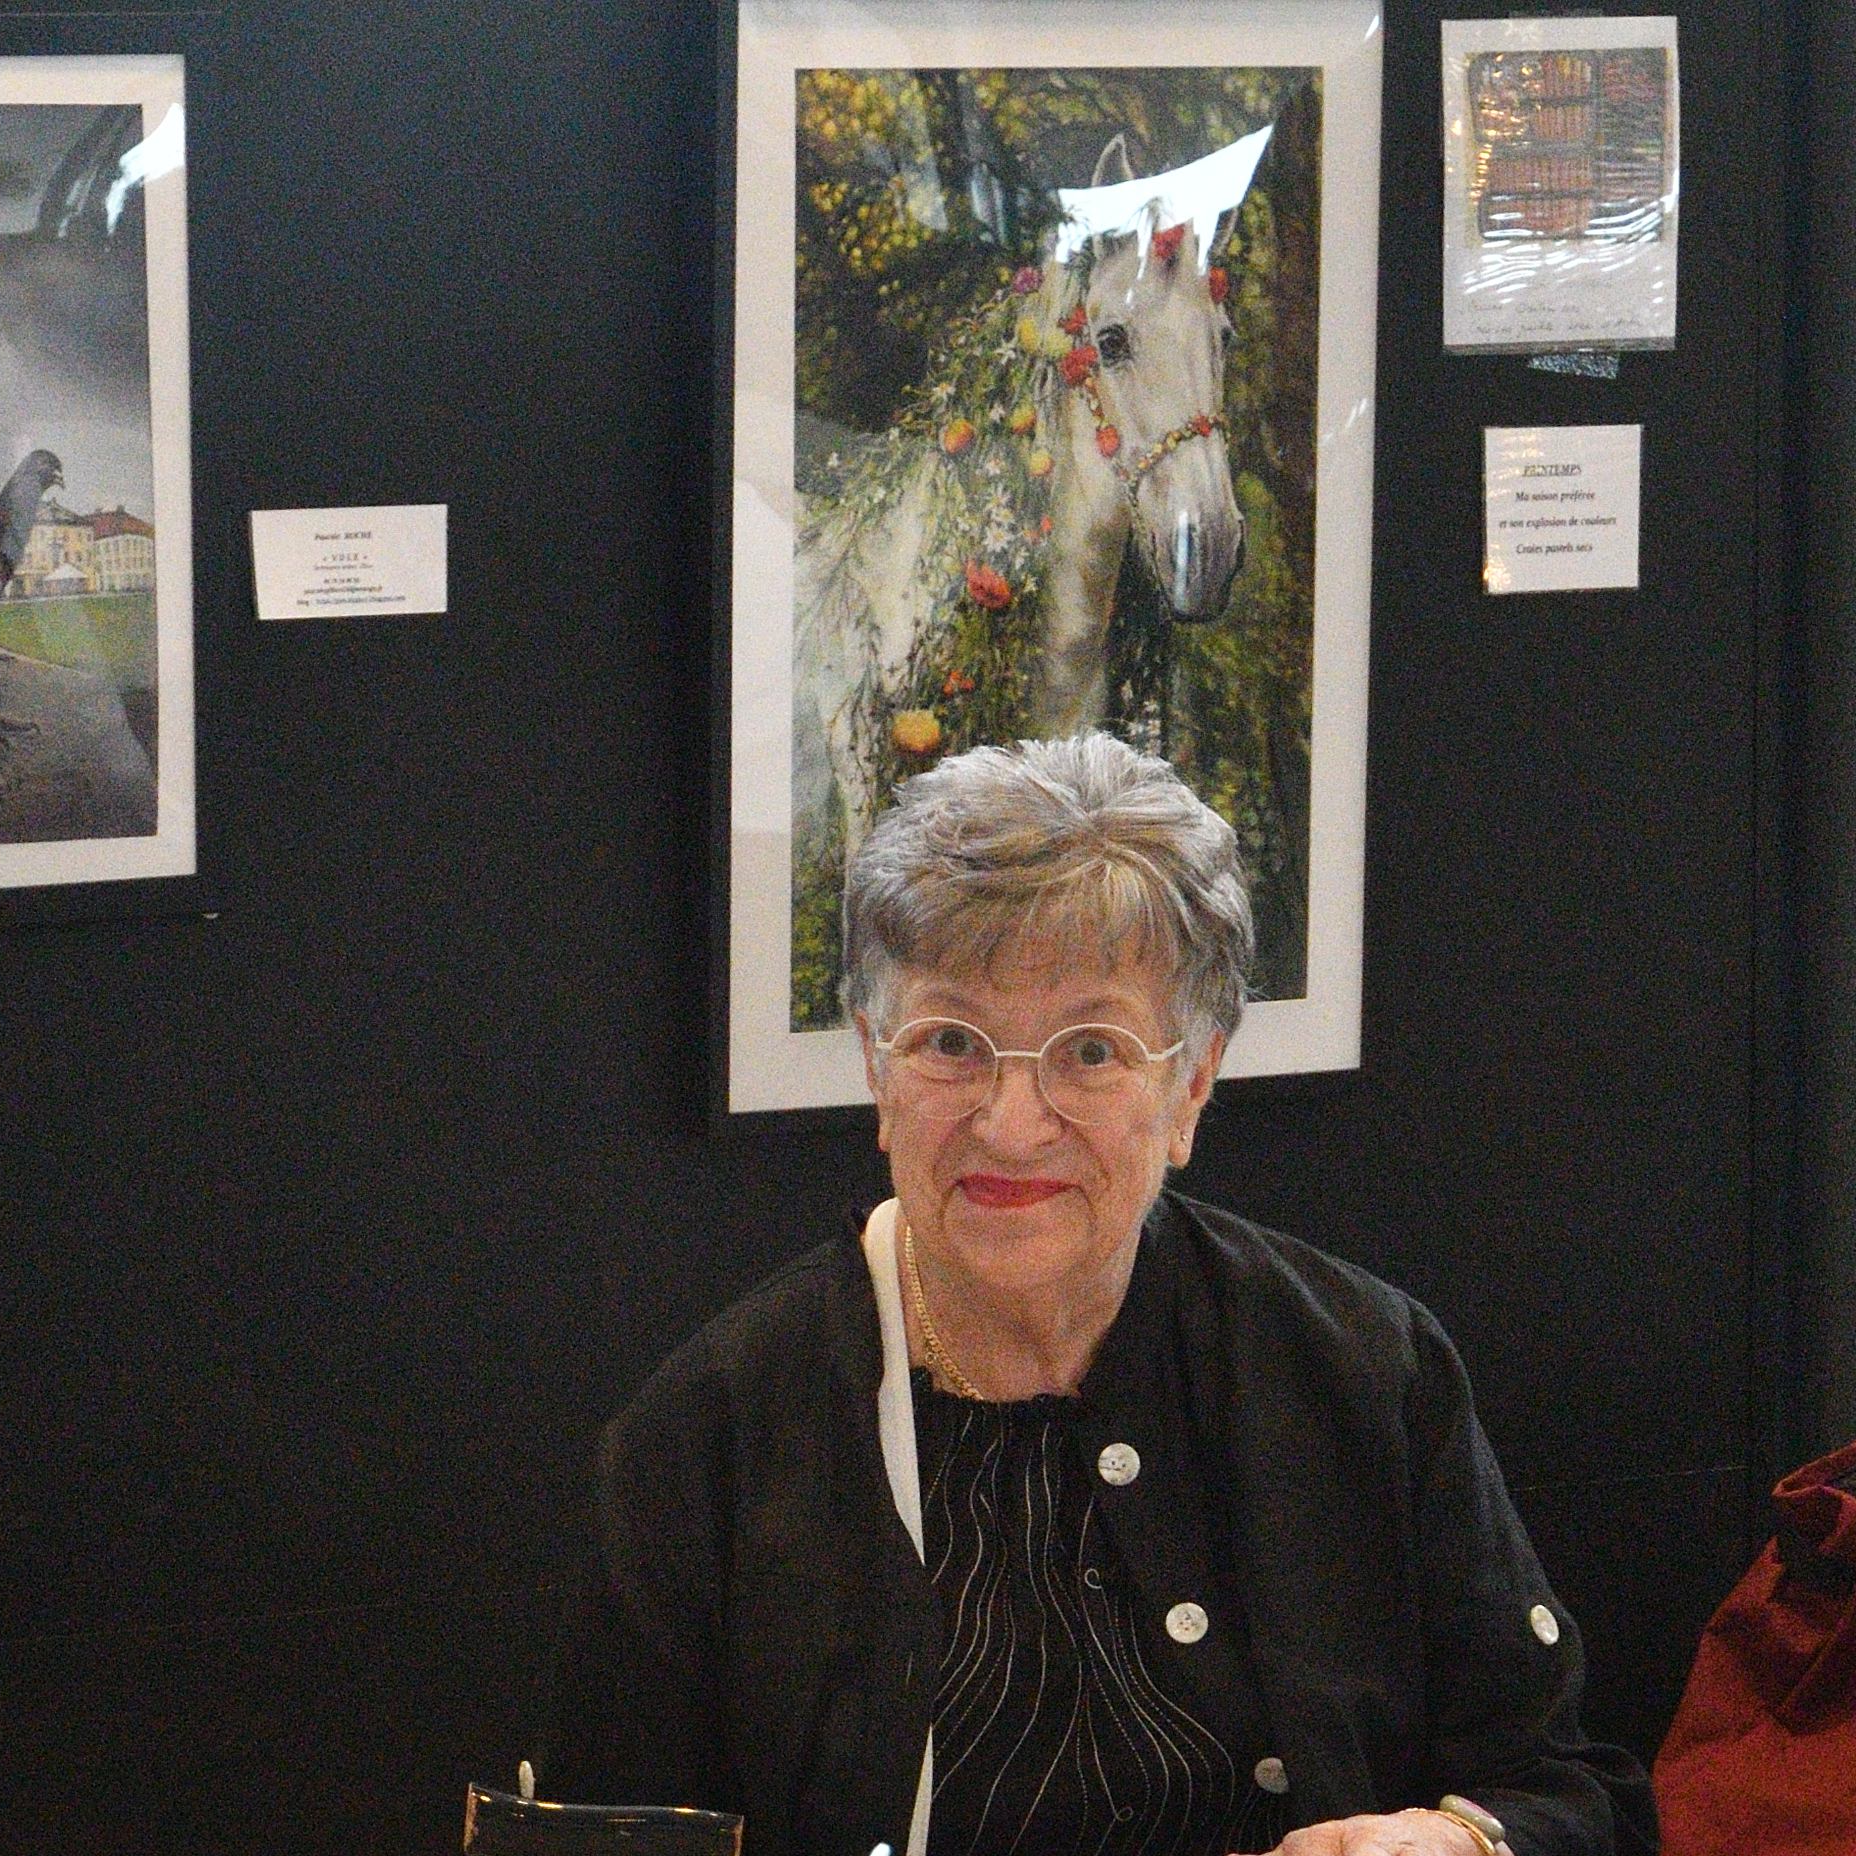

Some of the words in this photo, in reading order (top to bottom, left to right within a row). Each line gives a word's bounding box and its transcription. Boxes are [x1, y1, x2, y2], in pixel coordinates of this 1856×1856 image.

[1522, 464, 1582, 477] PRINTEMPS
[1515, 491, 1529, 501] Ma
[1531, 491, 1559, 501] saison
[1526, 516, 1567, 529] explosion
[1568, 515, 1579, 526] de
